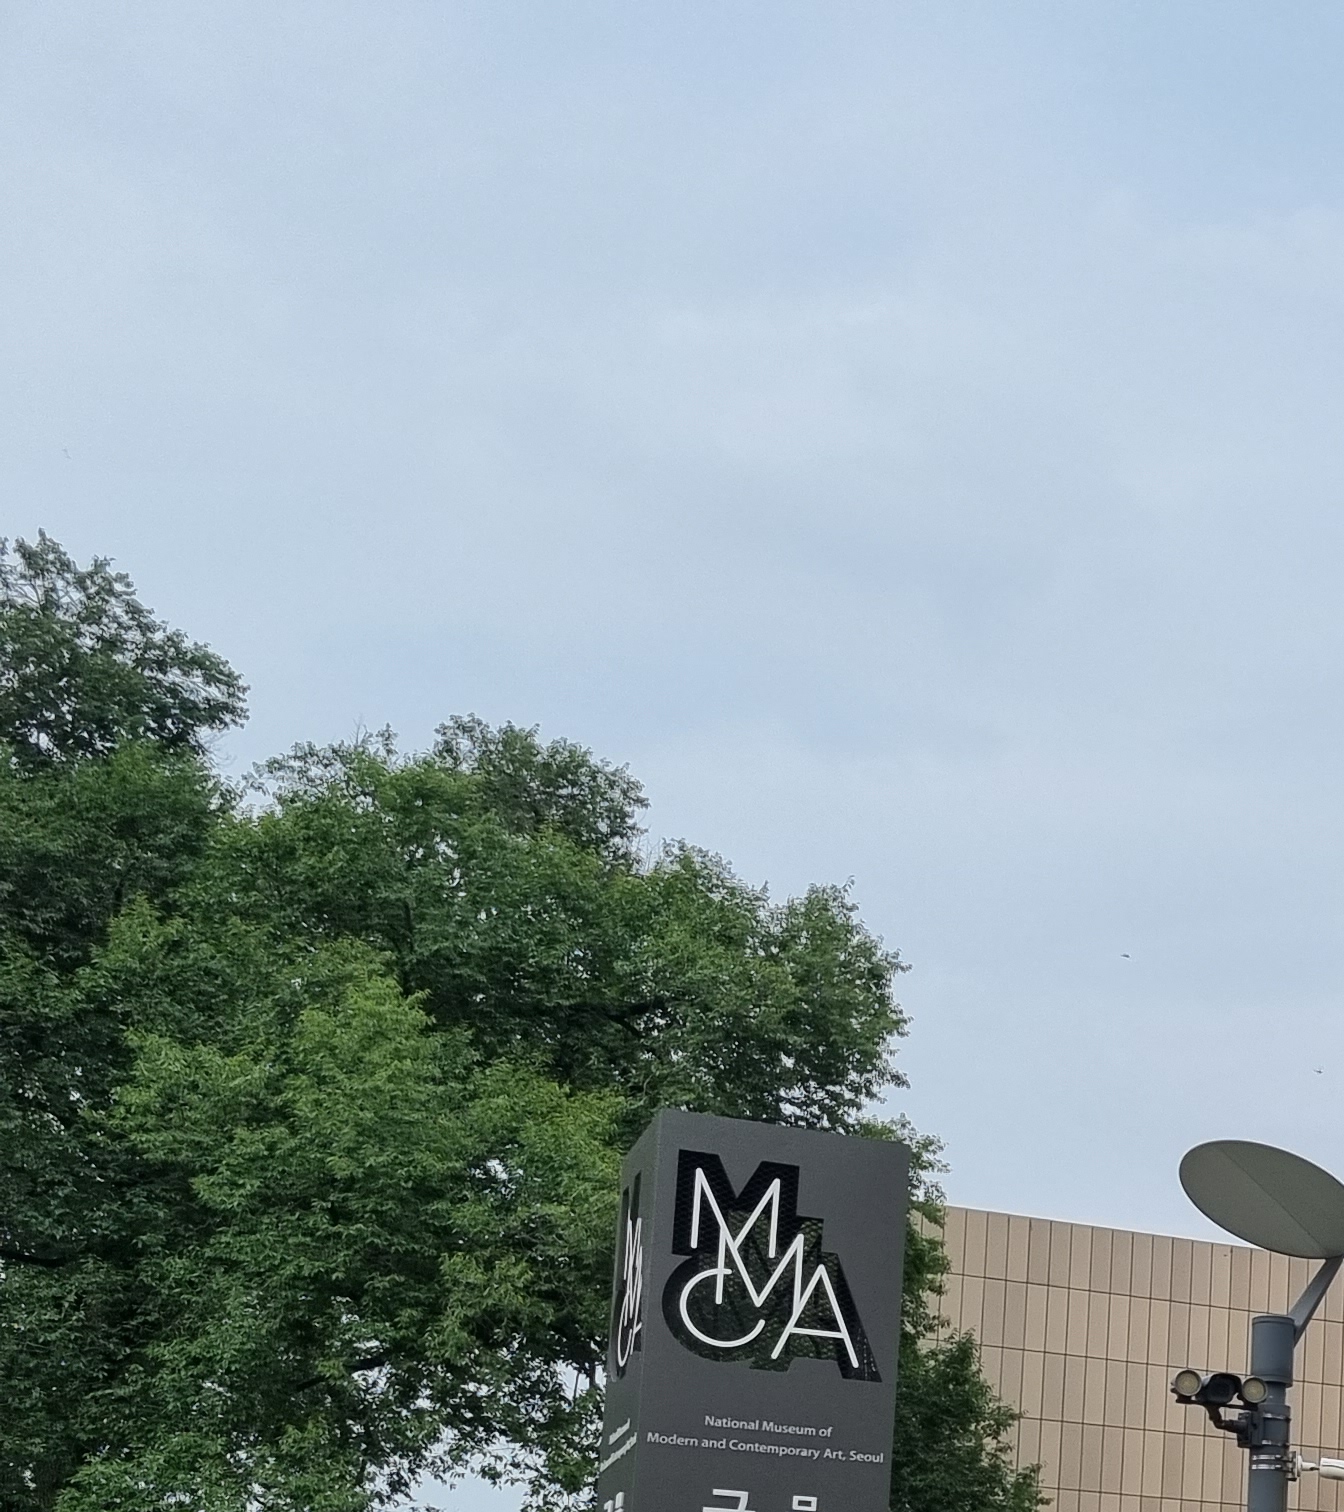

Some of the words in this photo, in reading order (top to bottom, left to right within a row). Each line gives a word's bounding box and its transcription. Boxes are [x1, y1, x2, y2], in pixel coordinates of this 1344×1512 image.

[704, 1415, 760, 1431] National
[762, 1420, 816, 1436] Museum
[819, 1426, 833, 1437] of
[646, 1431, 699, 1447] Modern
[701, 1438, 727, 1449] and
[728, 1439, 820, 1459] Contemporary
[823, 1448, 847, 1461] Art,
[849, 1451, 884, 1463] Seoul
